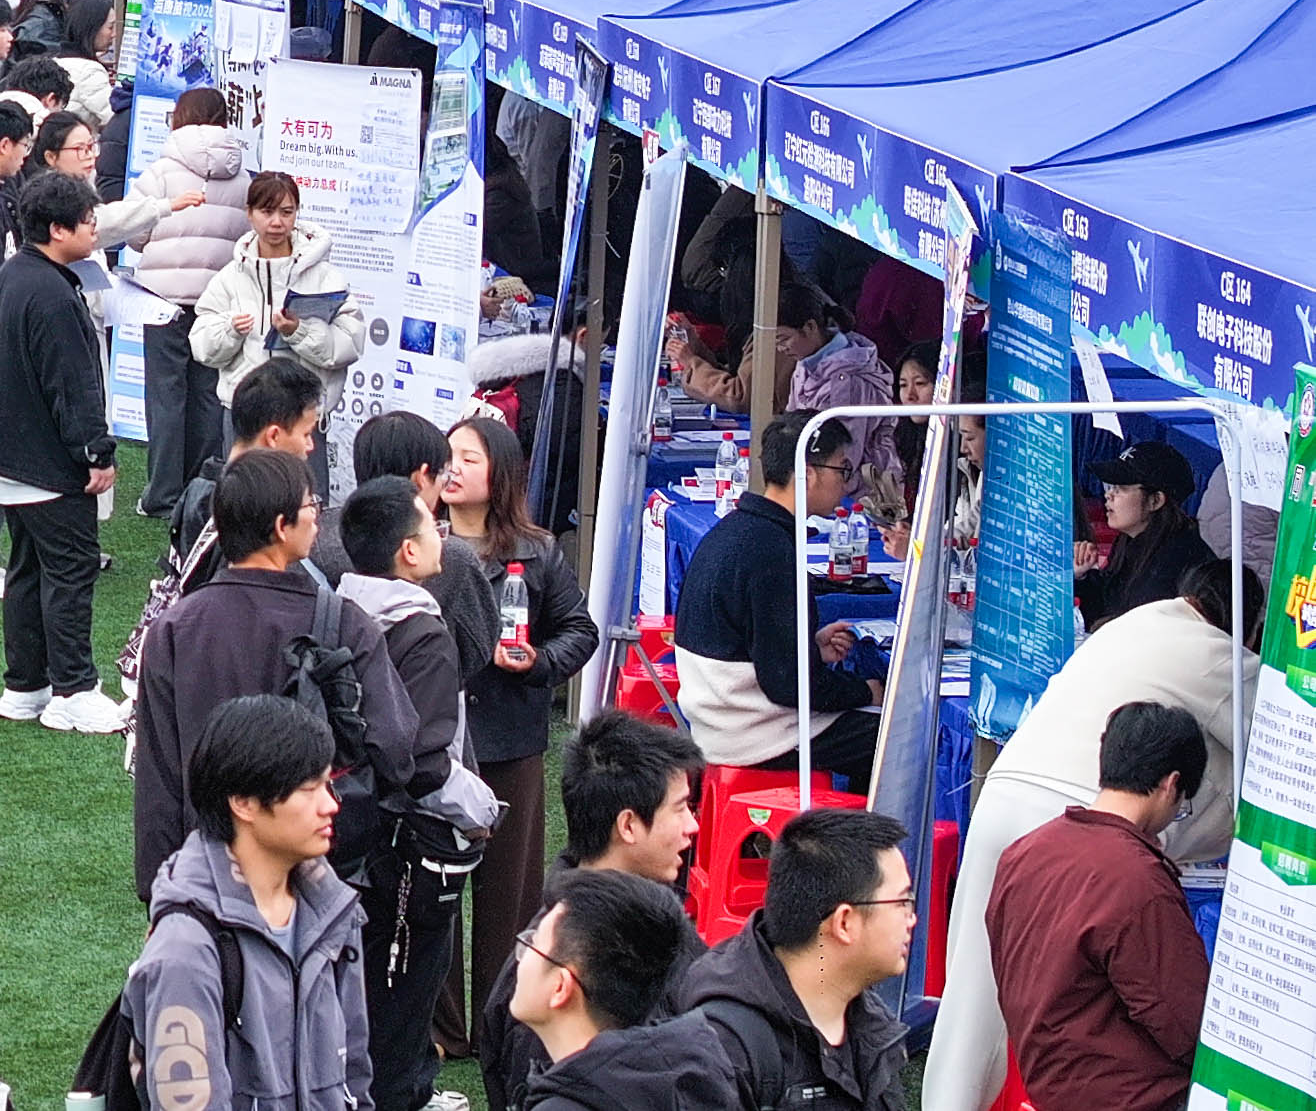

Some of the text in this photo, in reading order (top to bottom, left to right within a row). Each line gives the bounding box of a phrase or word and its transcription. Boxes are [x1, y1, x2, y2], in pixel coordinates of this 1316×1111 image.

[380, 76, 412, 89] MAGNA
[280, 117, 333, 141] 大有可为
[280, 140, 308, 153] Dream
[280, 154, 295, 164] And
[1062, 208, 1089, 241] C区 163
[918, 229, 946, 269] 有限公司
[1220, 271, 1251, 306] C区 164
[1071, 290, 1090, 328] 公司
[1196, 302, 1273, 366] 联创电子科技股份
[1214, 353, 1253, 400] 有限公司
